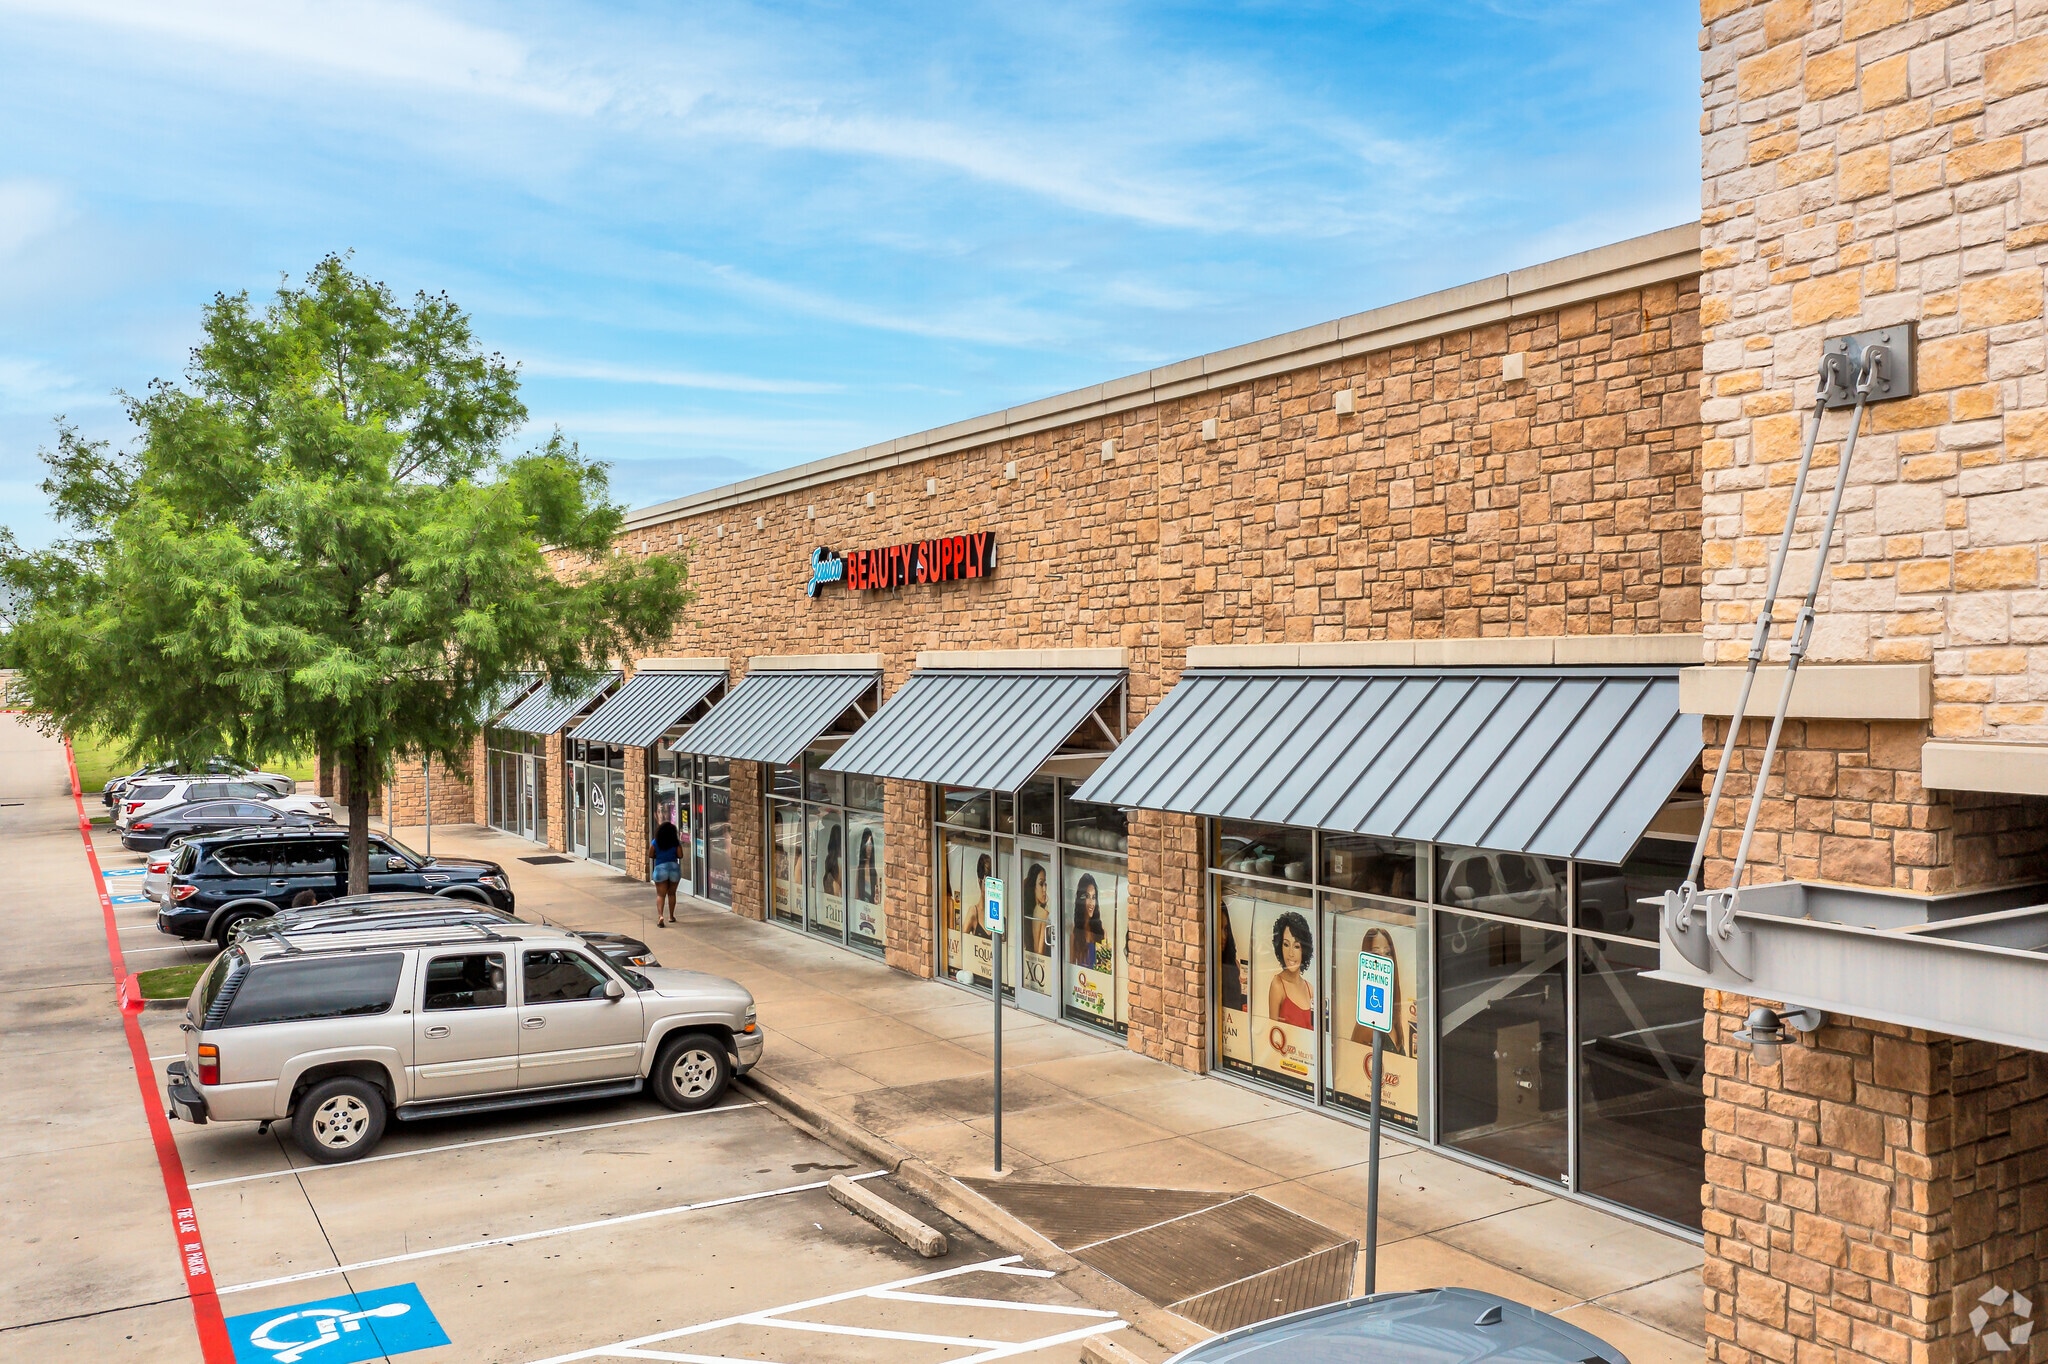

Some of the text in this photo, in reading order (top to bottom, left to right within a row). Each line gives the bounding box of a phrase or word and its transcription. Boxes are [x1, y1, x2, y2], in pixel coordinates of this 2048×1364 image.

[848, 543, 913, 591] BEAUTY
[917, 531, 988, 584] SUPPLY
[1025, 960, 1046, 988] XQ
[1361, 957, 1391, 975] RESERVED
[1362, 970, 1390, 987] PARKING
